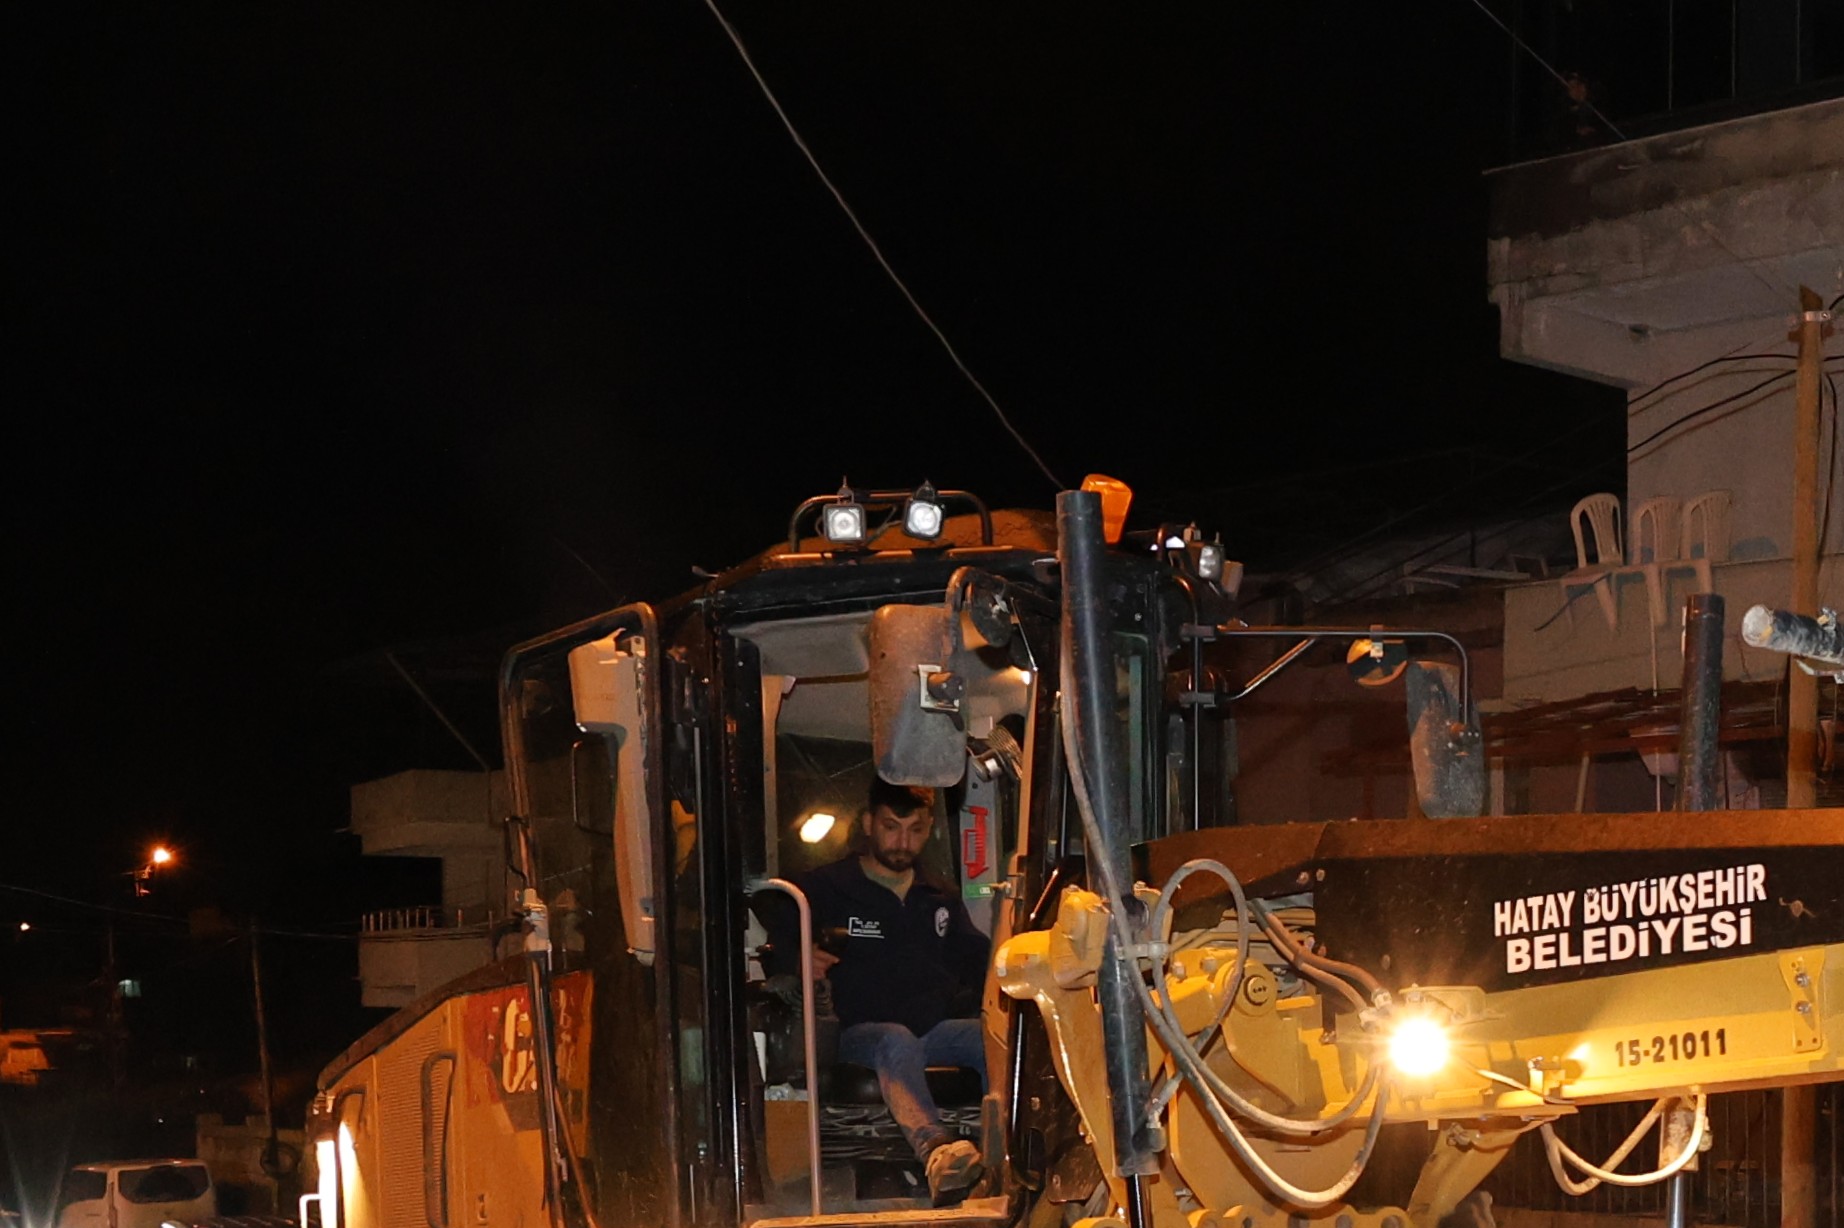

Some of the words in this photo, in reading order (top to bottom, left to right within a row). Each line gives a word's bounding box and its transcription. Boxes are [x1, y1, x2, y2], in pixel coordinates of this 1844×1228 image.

[1494, 890, 1576, 937] HATAY
[1583, 863, 1767, 924] BÜYÜKŞEHİR
[1506, 908, 1752, 974] BELEDİYESİ
[1615, 1028, 1727, 1067] 15-21011
